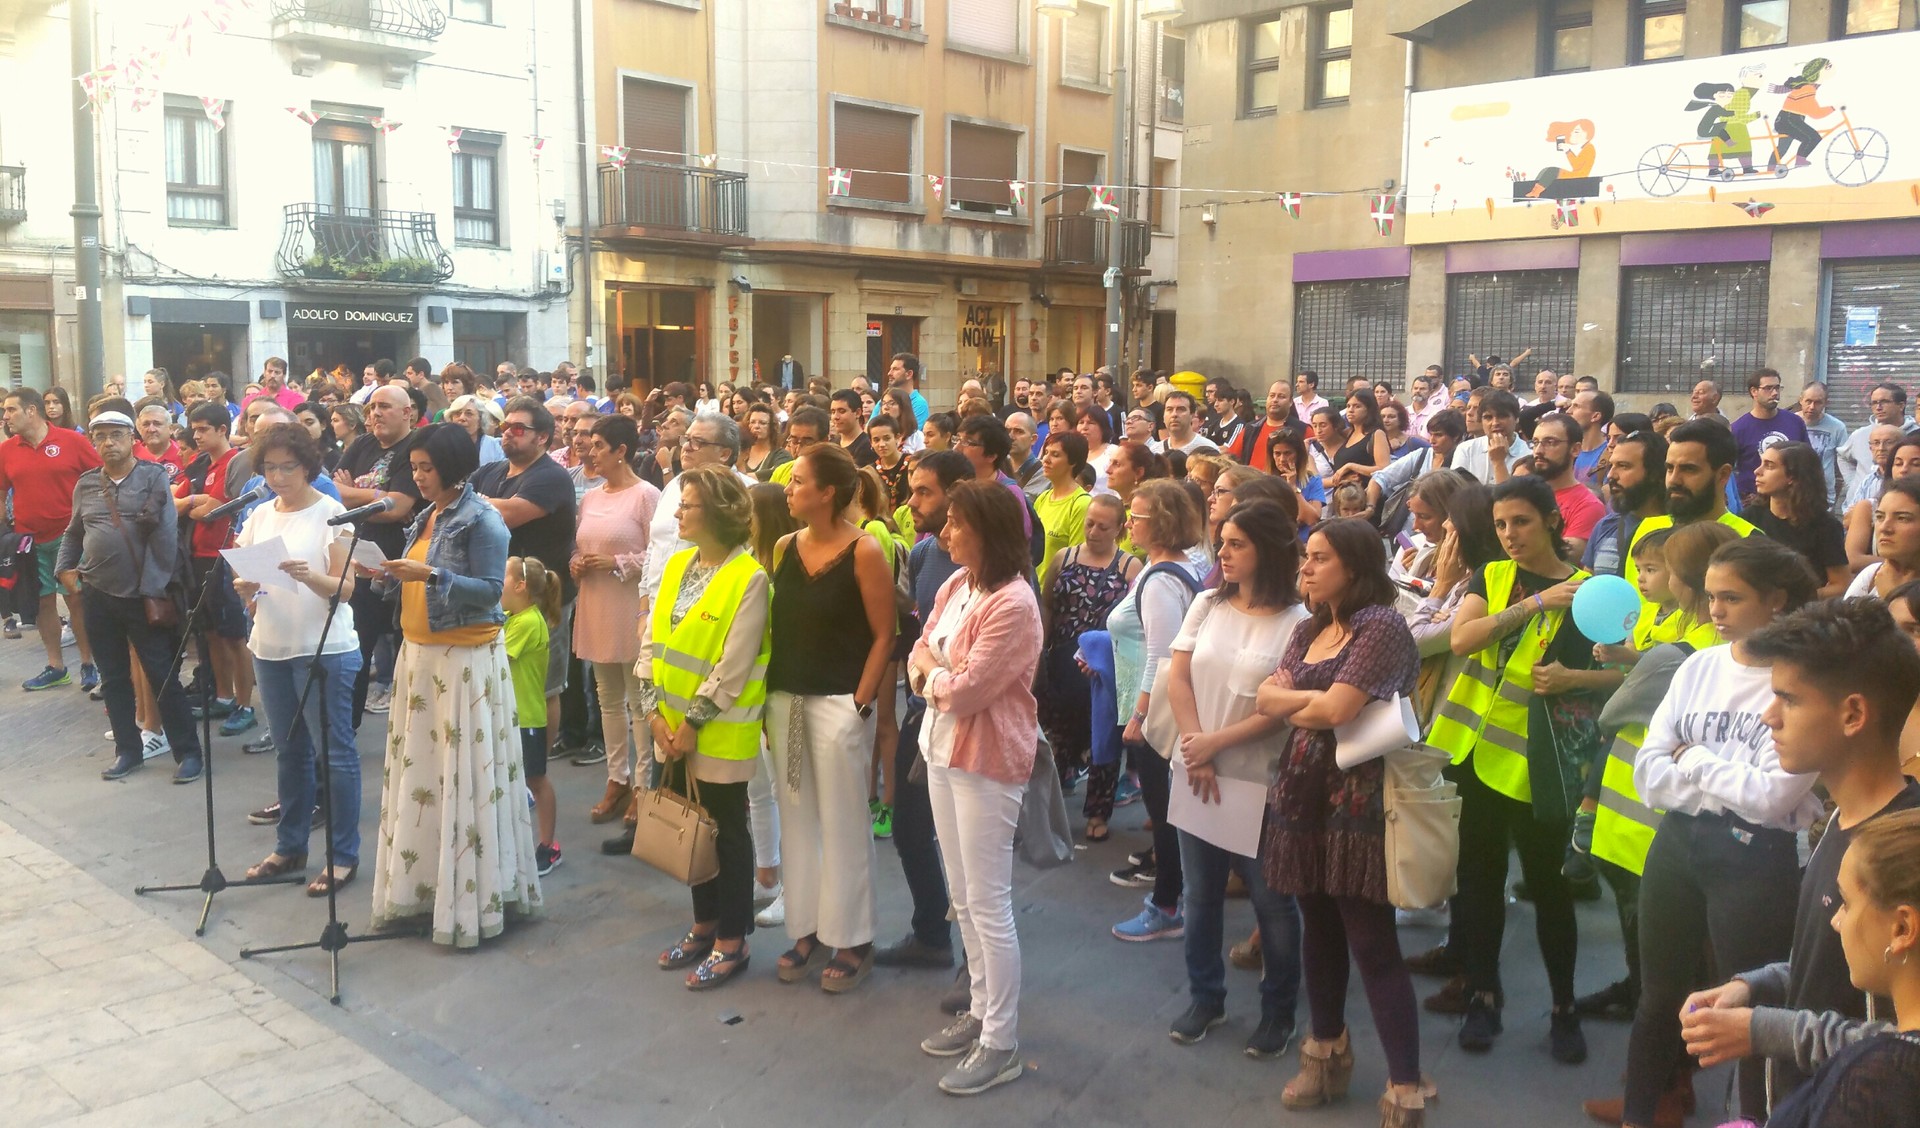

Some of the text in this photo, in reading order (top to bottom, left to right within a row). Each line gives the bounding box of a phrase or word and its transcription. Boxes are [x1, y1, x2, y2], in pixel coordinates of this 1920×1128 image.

[292, 309, 413, 323] ADOLFO DOMINGUEZ
[965, 305, 993, 326] ACT
[962, 327, 995, 347] NOW
